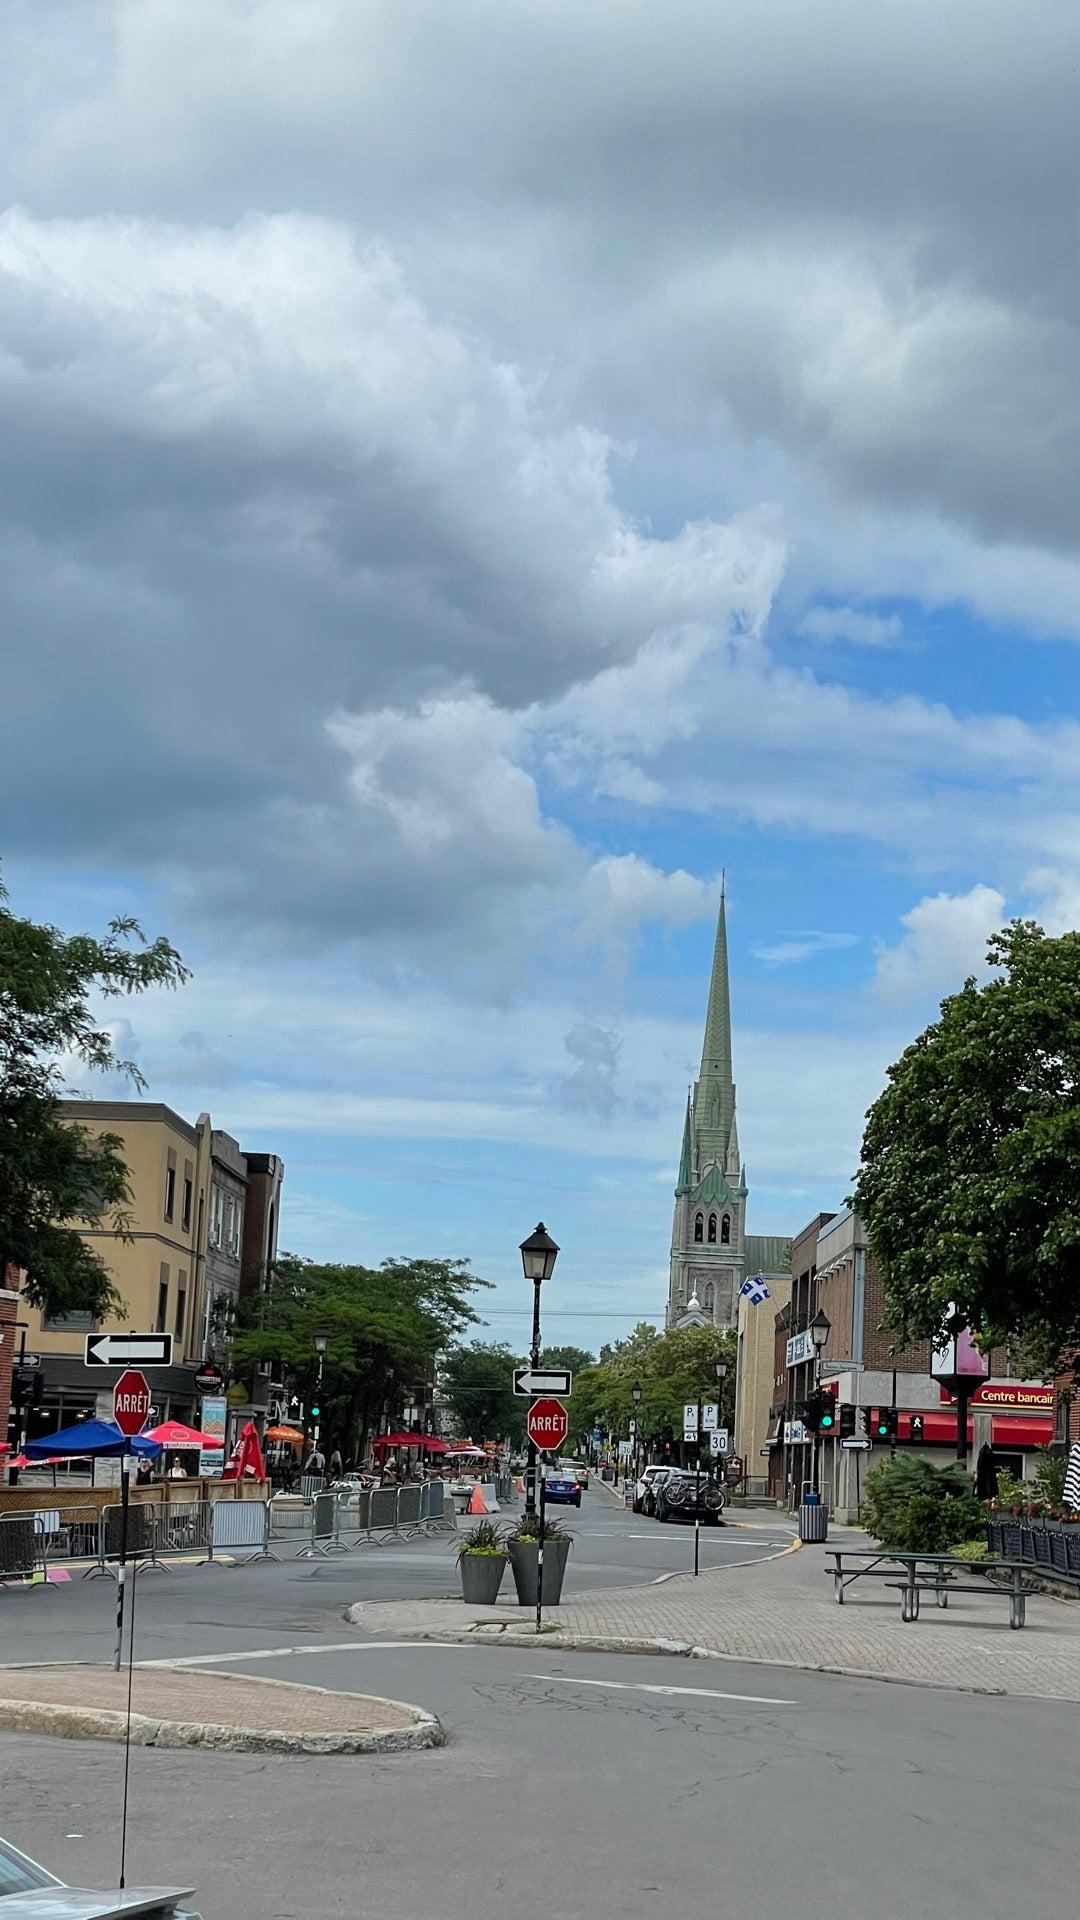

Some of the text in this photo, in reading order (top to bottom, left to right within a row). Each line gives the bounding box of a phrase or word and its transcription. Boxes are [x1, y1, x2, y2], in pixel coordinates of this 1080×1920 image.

[116, 1390, 148, 1414] ARRÊT
[981, 1390, 1015, 1402] Centre
[707, 1406, 714, 1417] P
[530, 1414, 566, 1432] ARRÊT
[712, 1437, 726, 1449] 30
